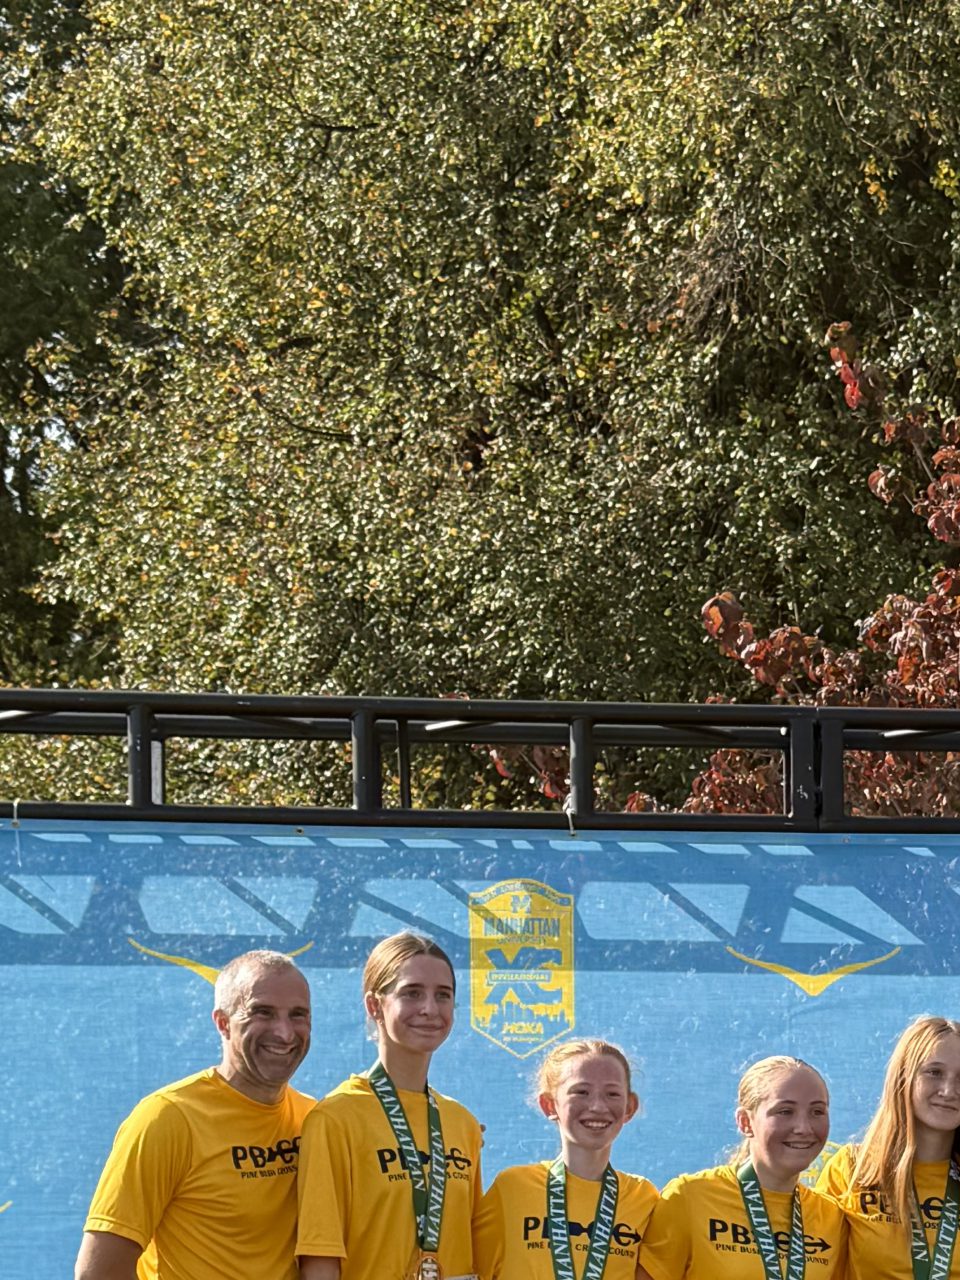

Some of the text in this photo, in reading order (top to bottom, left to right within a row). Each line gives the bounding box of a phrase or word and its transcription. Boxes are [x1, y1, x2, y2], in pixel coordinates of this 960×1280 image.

[484, 918, 560, 936] MANHATTAN
[484, 947, 563, 1004] XC
[372, 1077, 426, 1191] MANHATTAN
[426, 1126, 442, 1248] MANHATTAN
[527, 1242, 544, 1250] PINE
[716, 1244, 737, 1252] PINE
[740, 1247, 760, 1255] BUS
